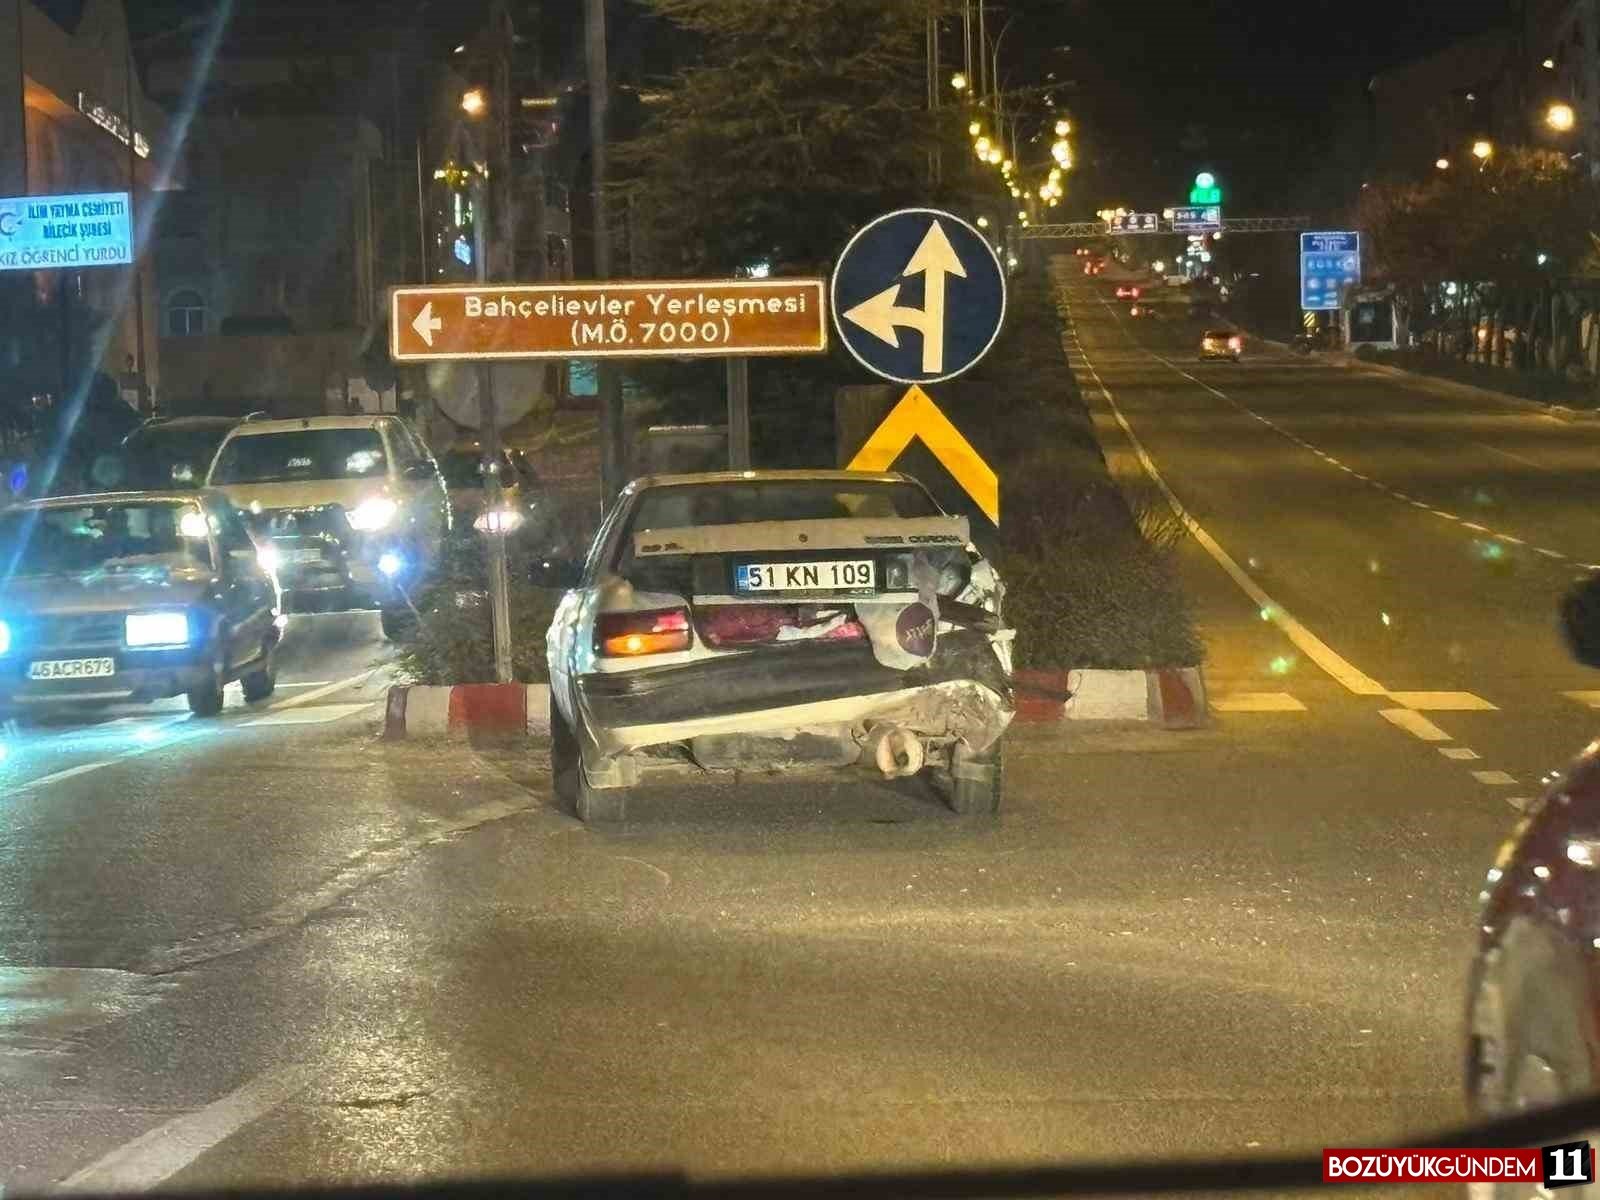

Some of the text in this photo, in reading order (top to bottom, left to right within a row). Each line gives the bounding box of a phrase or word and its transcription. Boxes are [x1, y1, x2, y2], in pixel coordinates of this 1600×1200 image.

[82, 246, 126, 262] YURDU
[464, 293, 806, 319] Bahçelievler Yerleşmesi
[639, 317, 731, 343] 7000)
[749, 563, 870, 588] 51 KN 109
